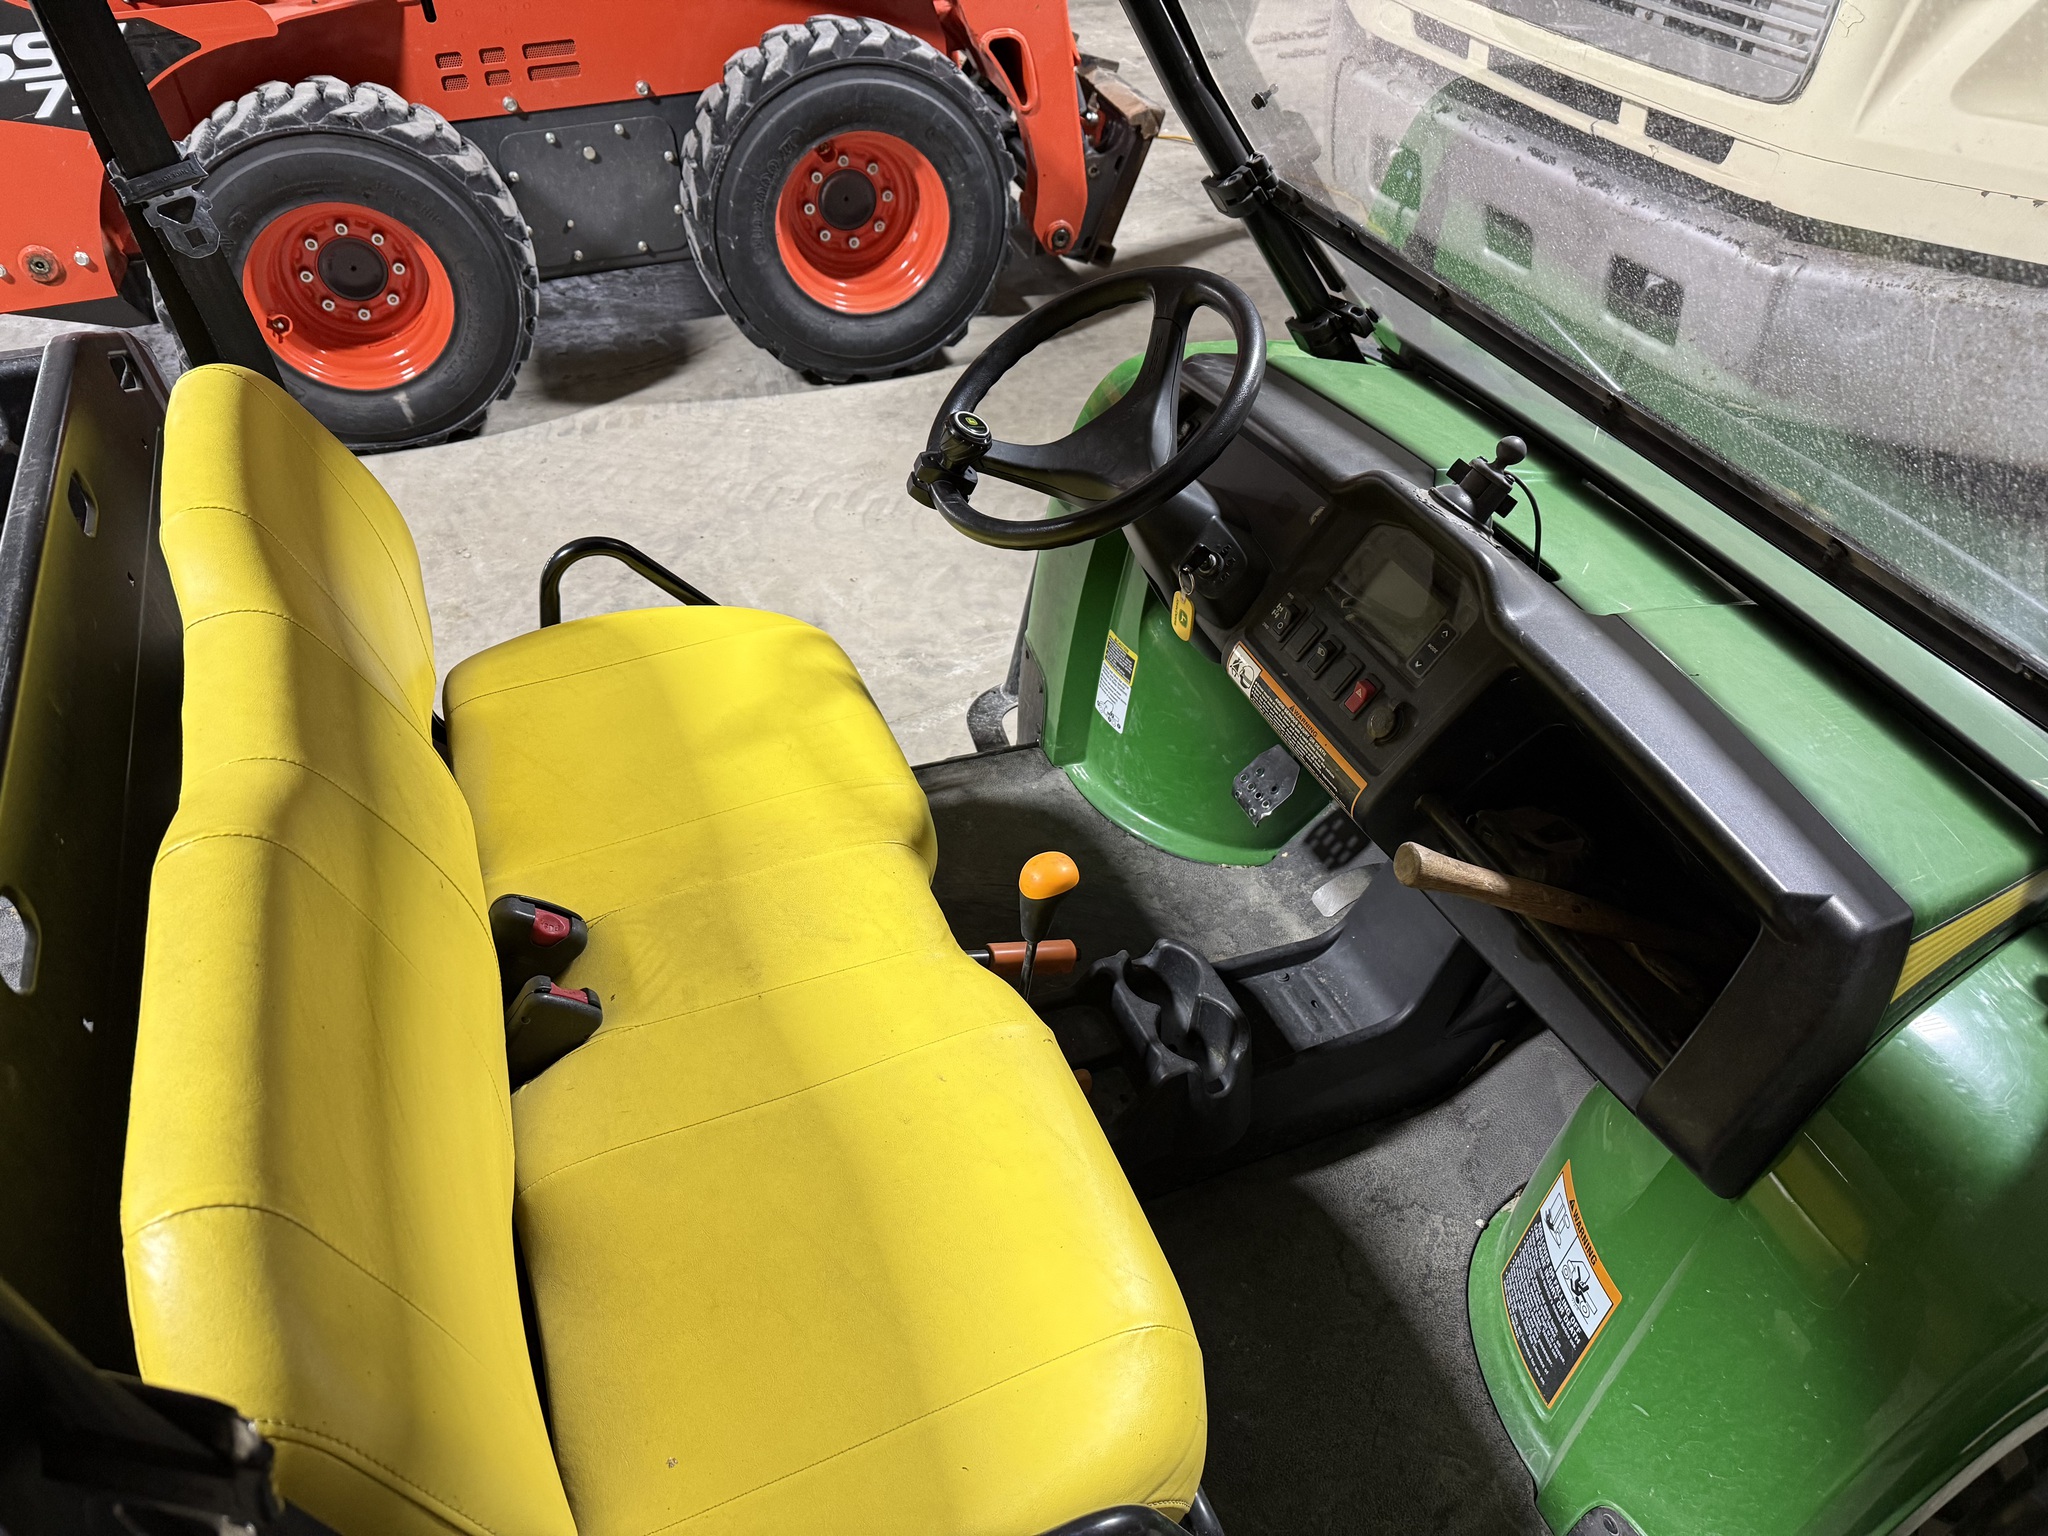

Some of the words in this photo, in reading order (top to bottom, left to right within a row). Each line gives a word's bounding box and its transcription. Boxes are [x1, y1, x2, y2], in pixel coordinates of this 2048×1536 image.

[1294, 710, 1318, 737] WARNING
[1314, 742, 1327, 756] DEATH
[1572, 1210, 1598, 1266] WARNING
[1536, 1238, 1547, 1272] CAUSE
[1544, 1266, 1557, 1301] INJURY
[1556, 1299, 1564, 1316] OR
[1562, 1313, 1580, 1345] DEATH
[1537, 1220, 1550, 1266] ROLLOVER
[1548, 1263, 1555, 1280] OR
[1553, 1277, 1571, 1317] FALLING
[1569, 1314, 1581, 1335] OFF
